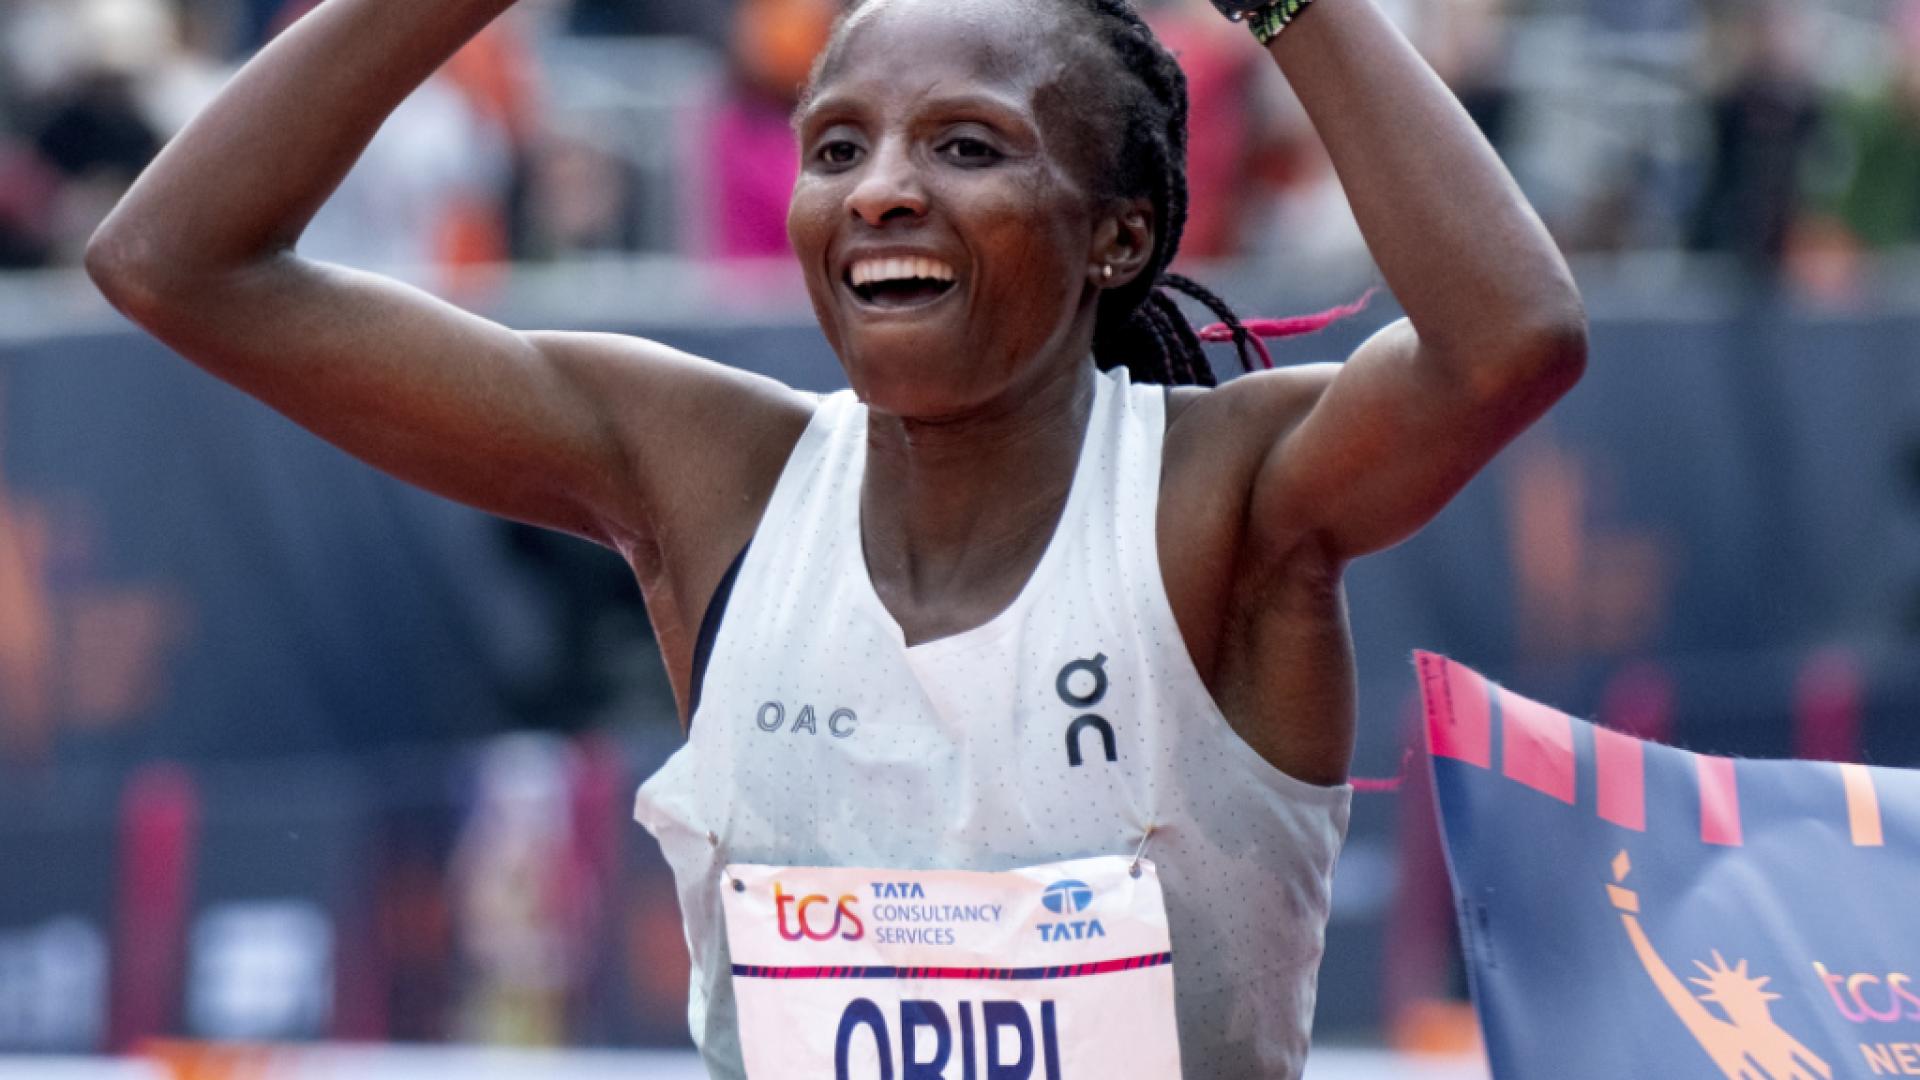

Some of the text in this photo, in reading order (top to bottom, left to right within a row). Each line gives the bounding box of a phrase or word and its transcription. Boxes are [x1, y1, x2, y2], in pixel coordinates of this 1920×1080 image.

[756, 699, 858, 738] OAC
[871, 882, 925, 898] TATA
[872, 904, 1002, 922] CONSULTANCY
[876, 927, 955, 944] SERVICES
[1036, 918, 1106, 942] TATA
[1859, 1043, 1920, 1075] NE
